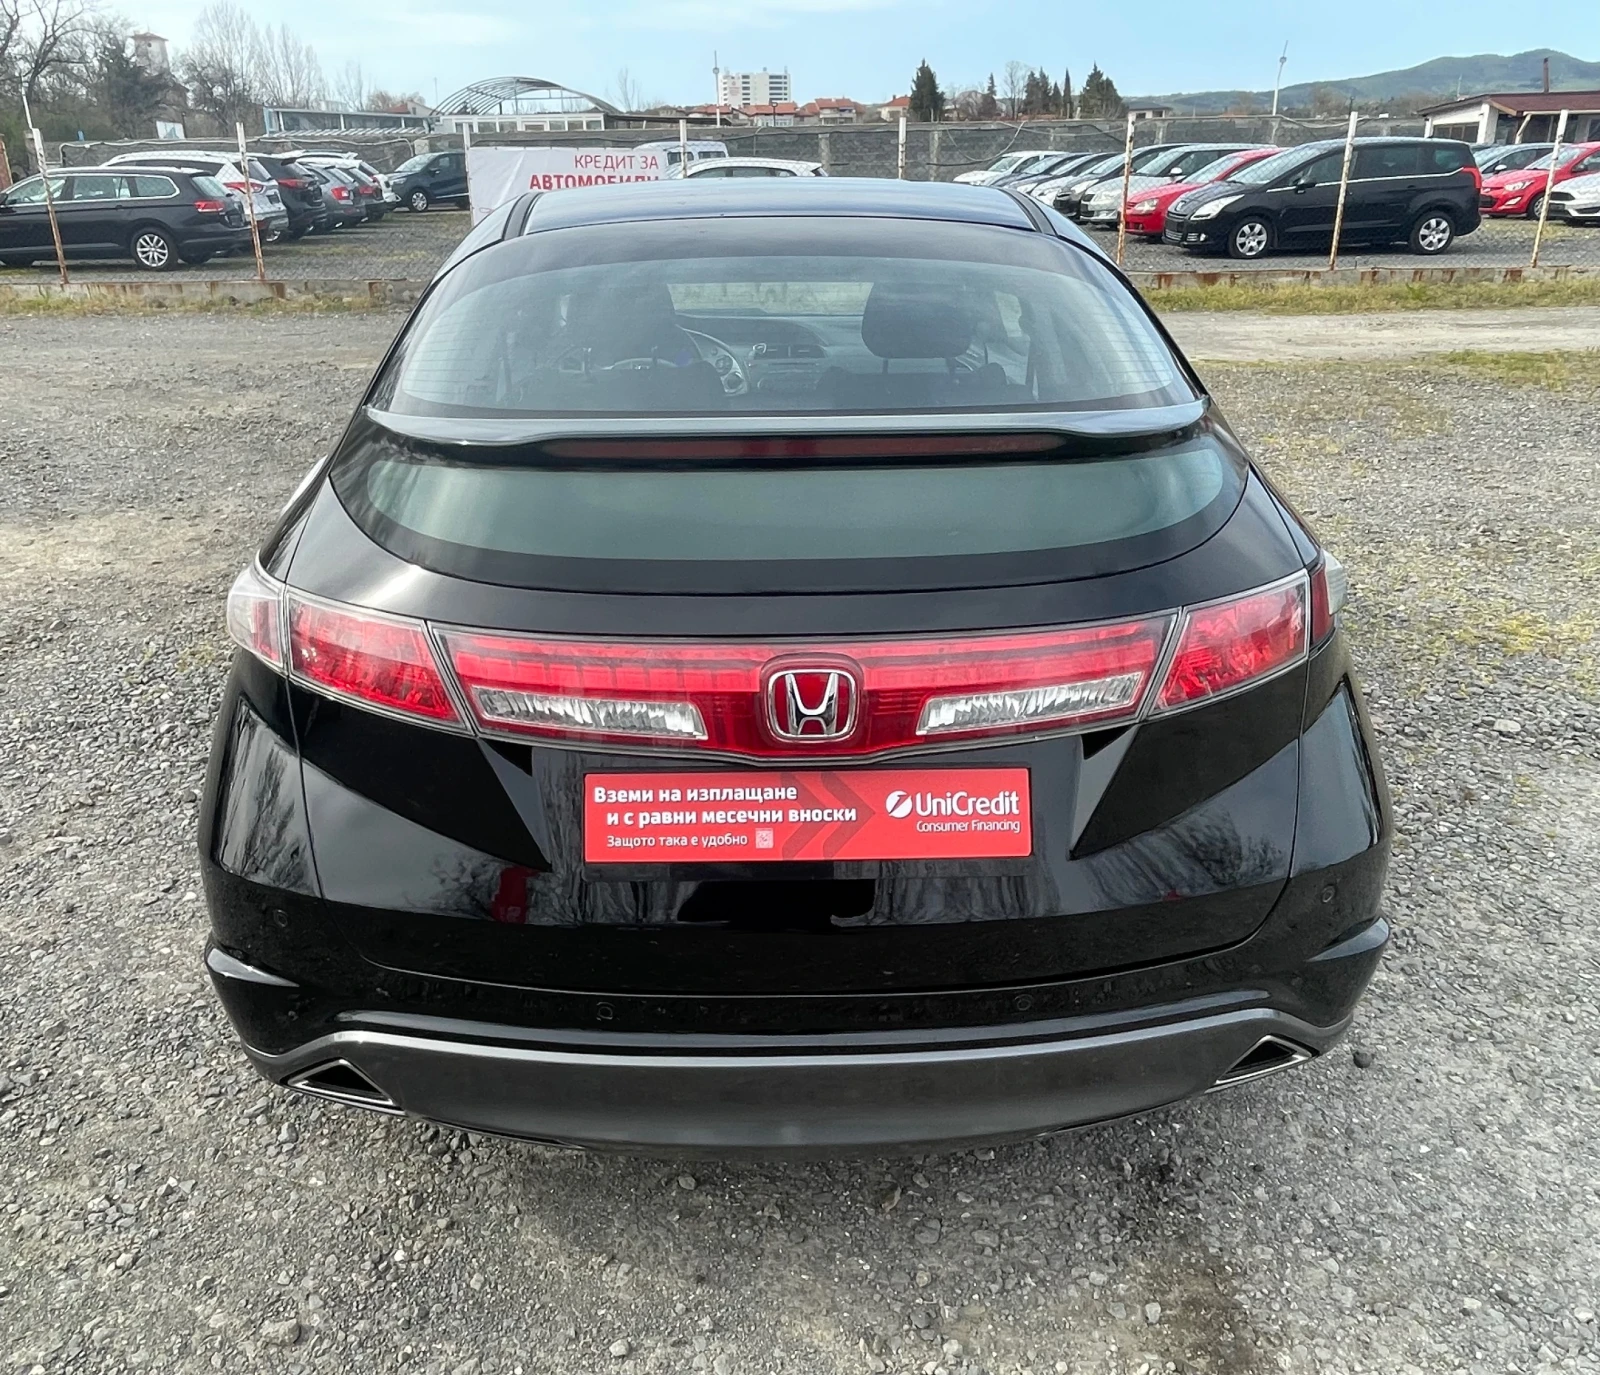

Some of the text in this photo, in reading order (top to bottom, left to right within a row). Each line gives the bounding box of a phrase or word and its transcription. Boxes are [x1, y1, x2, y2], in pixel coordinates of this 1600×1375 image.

[574, 154, 659, 172] КРЕДИТ ЗА
[593, 787, 797, 803] Вземи на изплащане
[916, 791, 1019, 816] UniCredit
[607, 809, 856, 828] и с равни месечни вноски
[916, 819, 1020, 833] Consumer Financing
[607, 833, 748, 848] Защото така е удобно
